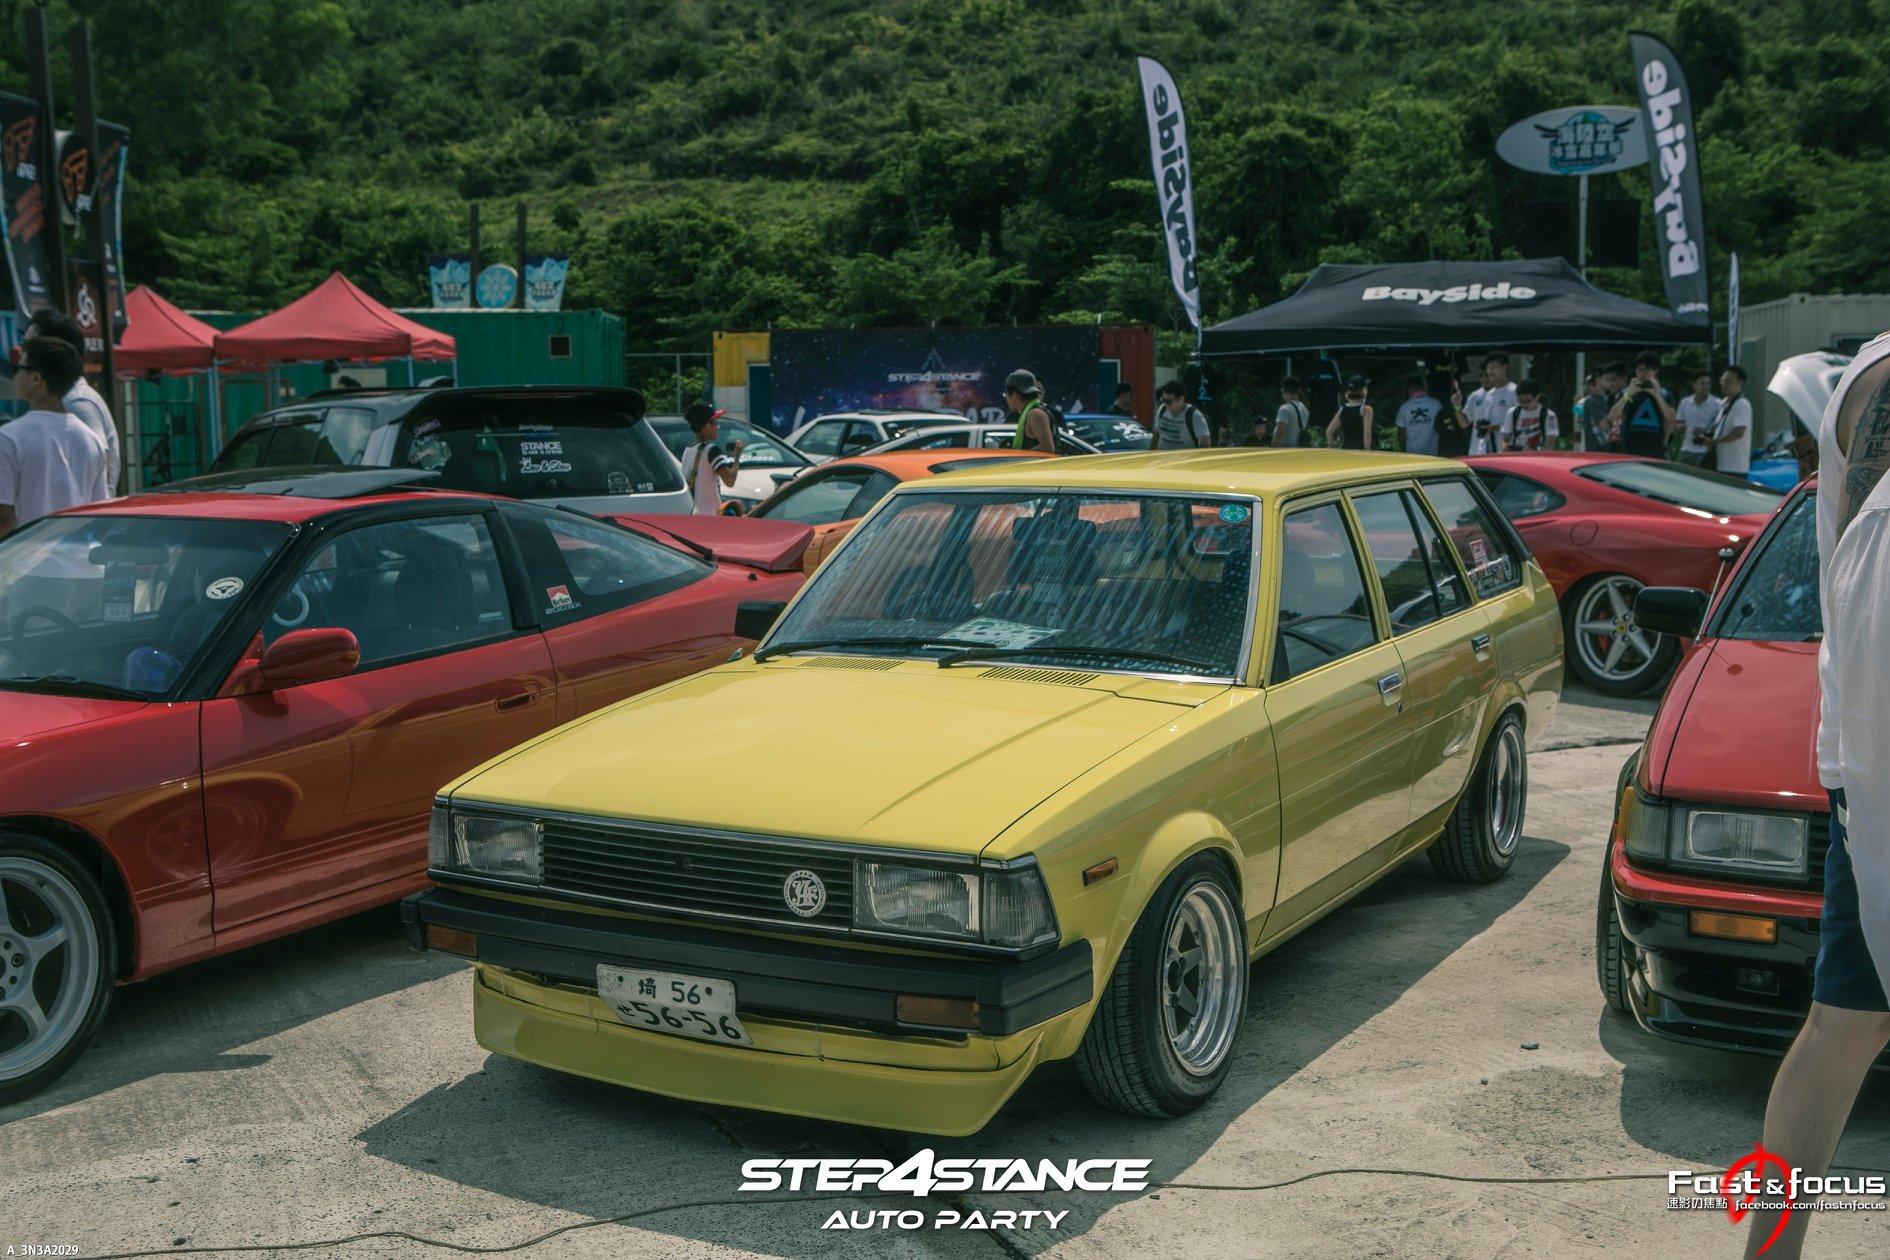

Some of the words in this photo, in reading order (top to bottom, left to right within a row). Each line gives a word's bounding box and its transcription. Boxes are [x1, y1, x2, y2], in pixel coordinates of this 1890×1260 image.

[1362, 282, 1537, 305] BaySide
[520, 441, 562, 450] STANCE
[638, 977, 657, 998] 埼
[671, 981, 700, 1004] 56
[630, 1001, 741, 1039] 56-56
